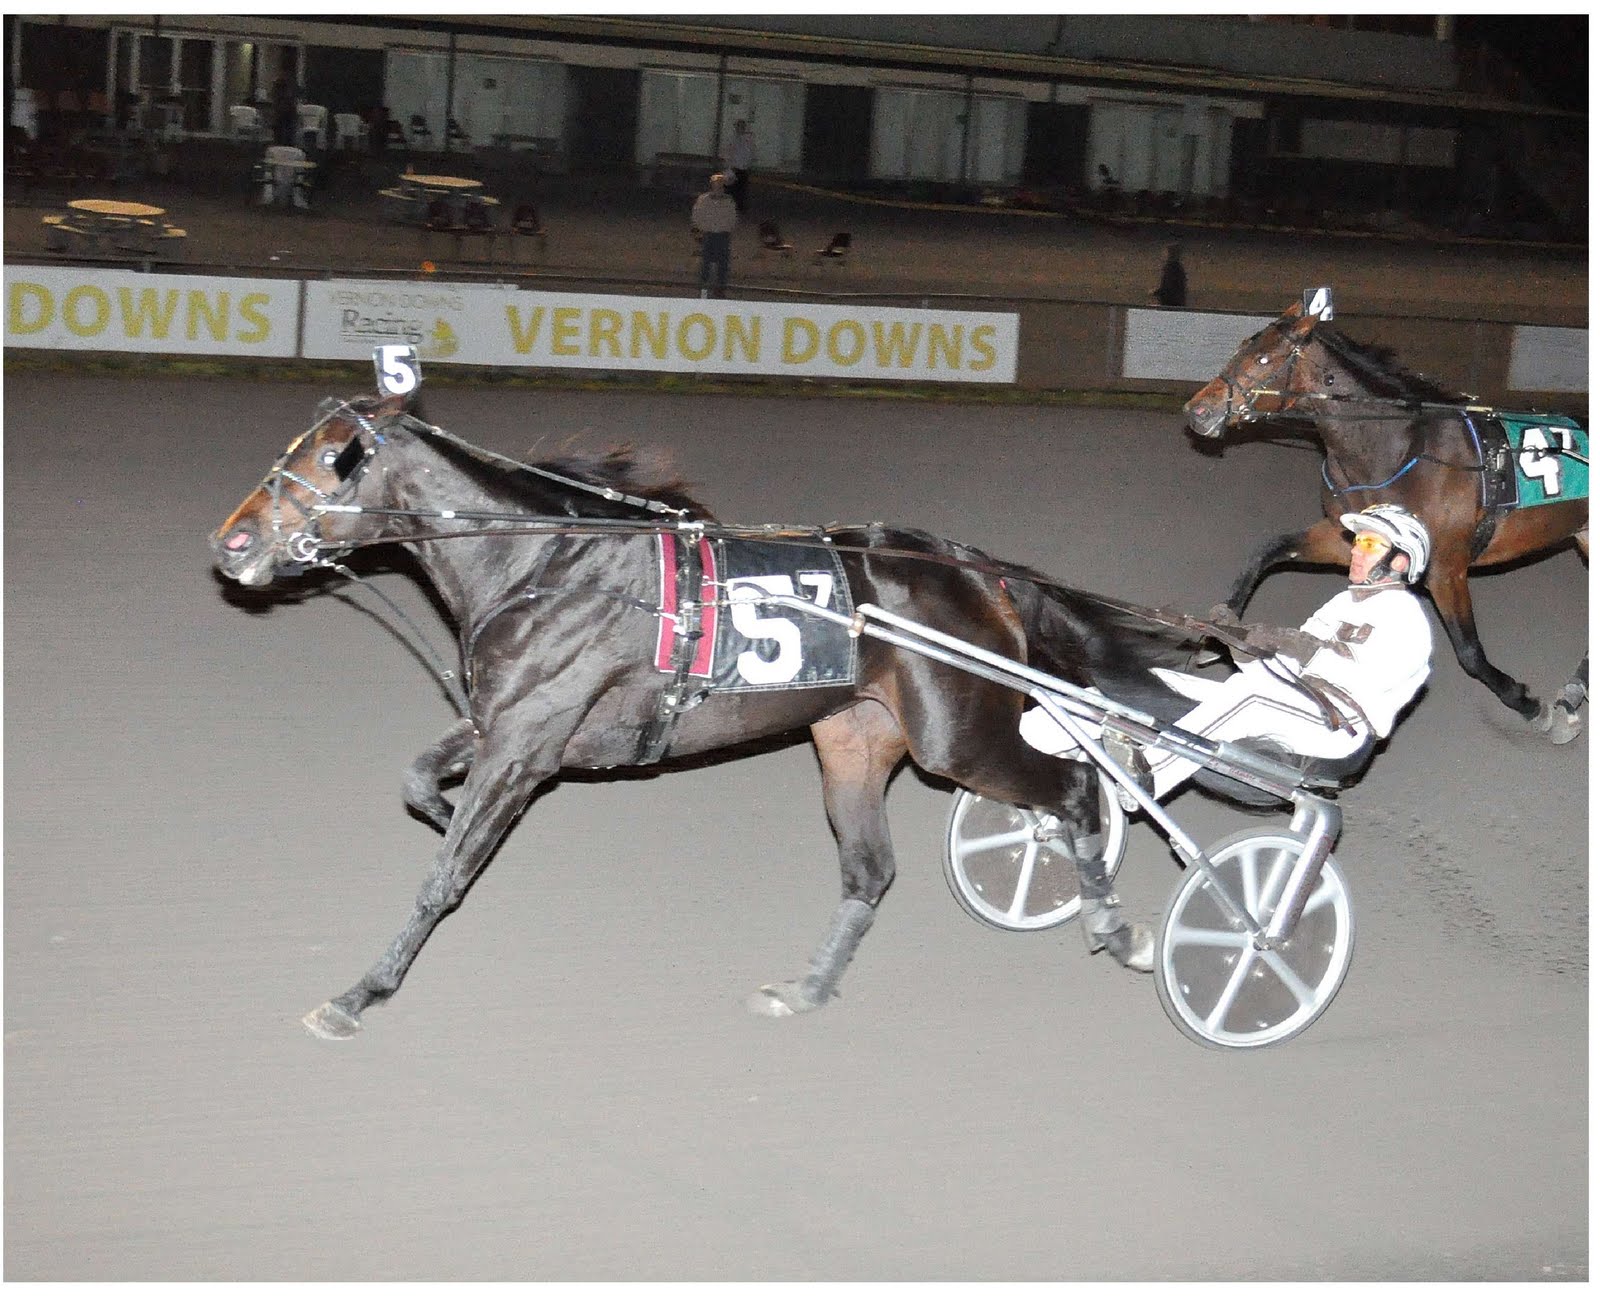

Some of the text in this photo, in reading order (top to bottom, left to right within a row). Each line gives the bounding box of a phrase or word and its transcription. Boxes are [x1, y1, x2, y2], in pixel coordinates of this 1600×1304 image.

[8, 281, 272, 343] DOWNS
[342, 308, 423, 344] Racing
[1309, 288, 1331, 321] 4
[505, 304, 997, 371] VERNON DOWNS
[382, 345, 417, 394] 5
[1519, 427, 1560, 496] 4
[727, 573, 833, 685] 5 7
